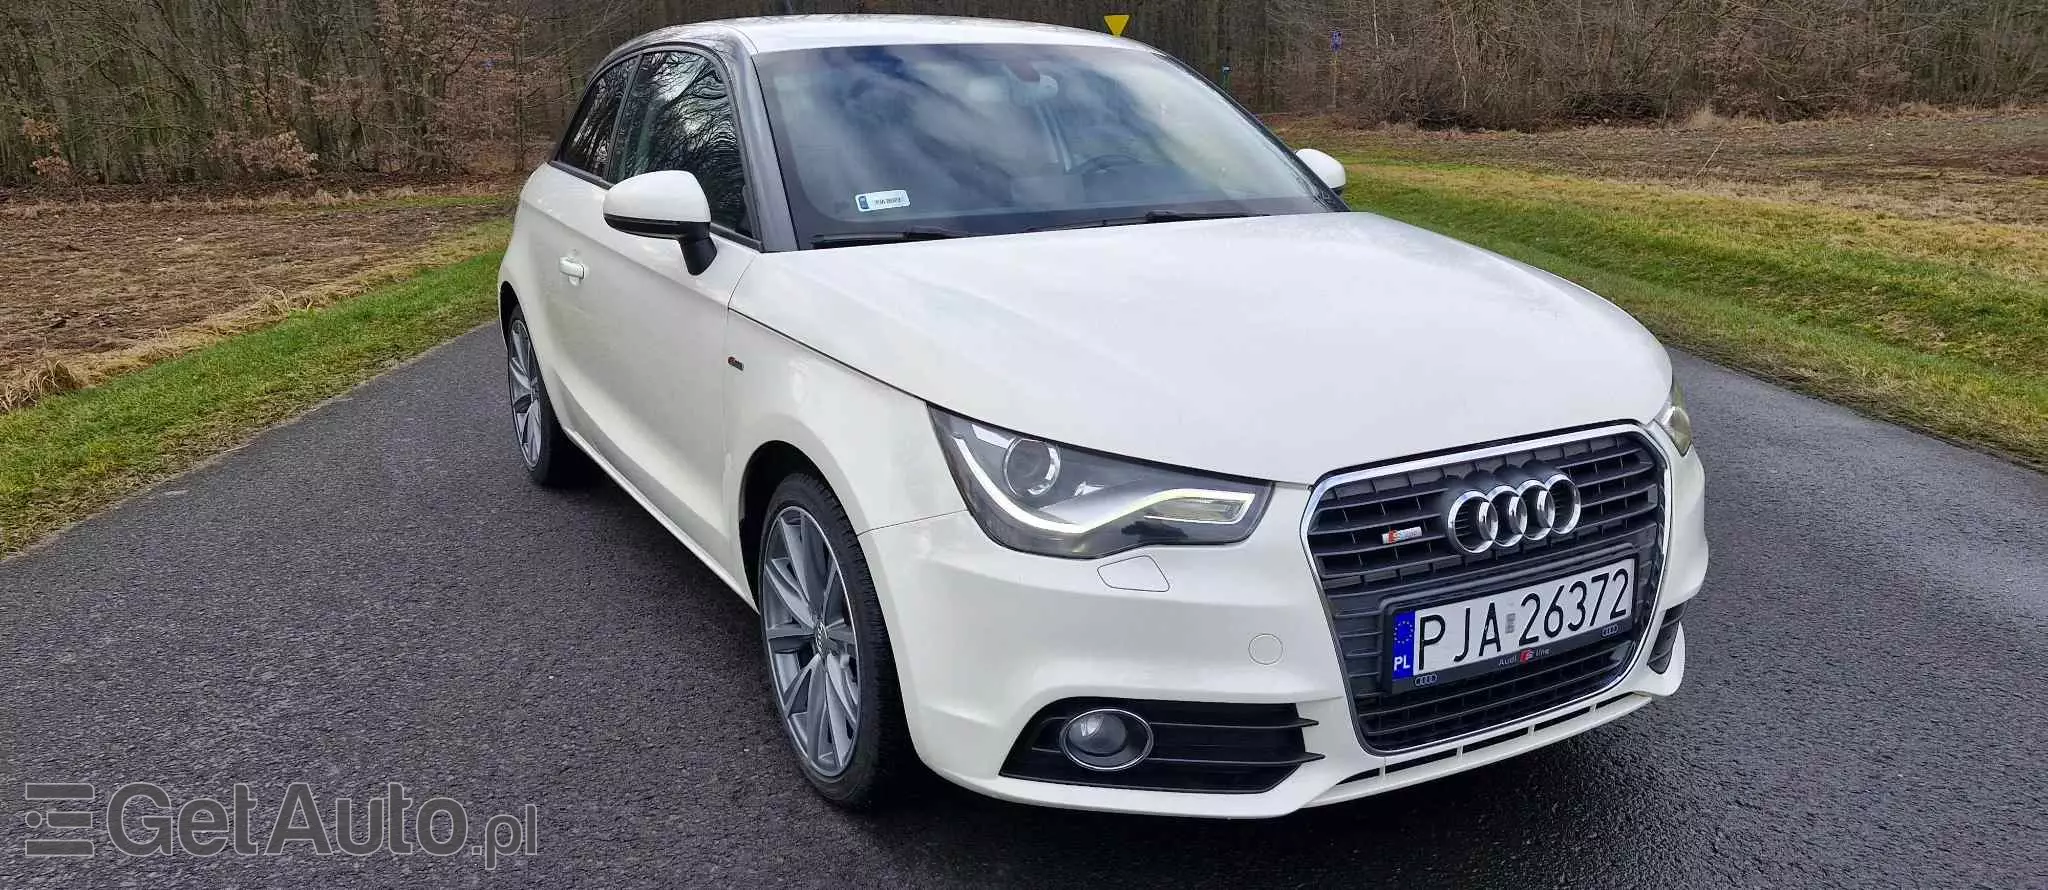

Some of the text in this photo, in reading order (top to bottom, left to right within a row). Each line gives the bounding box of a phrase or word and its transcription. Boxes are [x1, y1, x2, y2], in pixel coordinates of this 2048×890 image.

[1418, 568, 1629, 671] PJA 26372
[1393, 656, 1411, 671] PL
